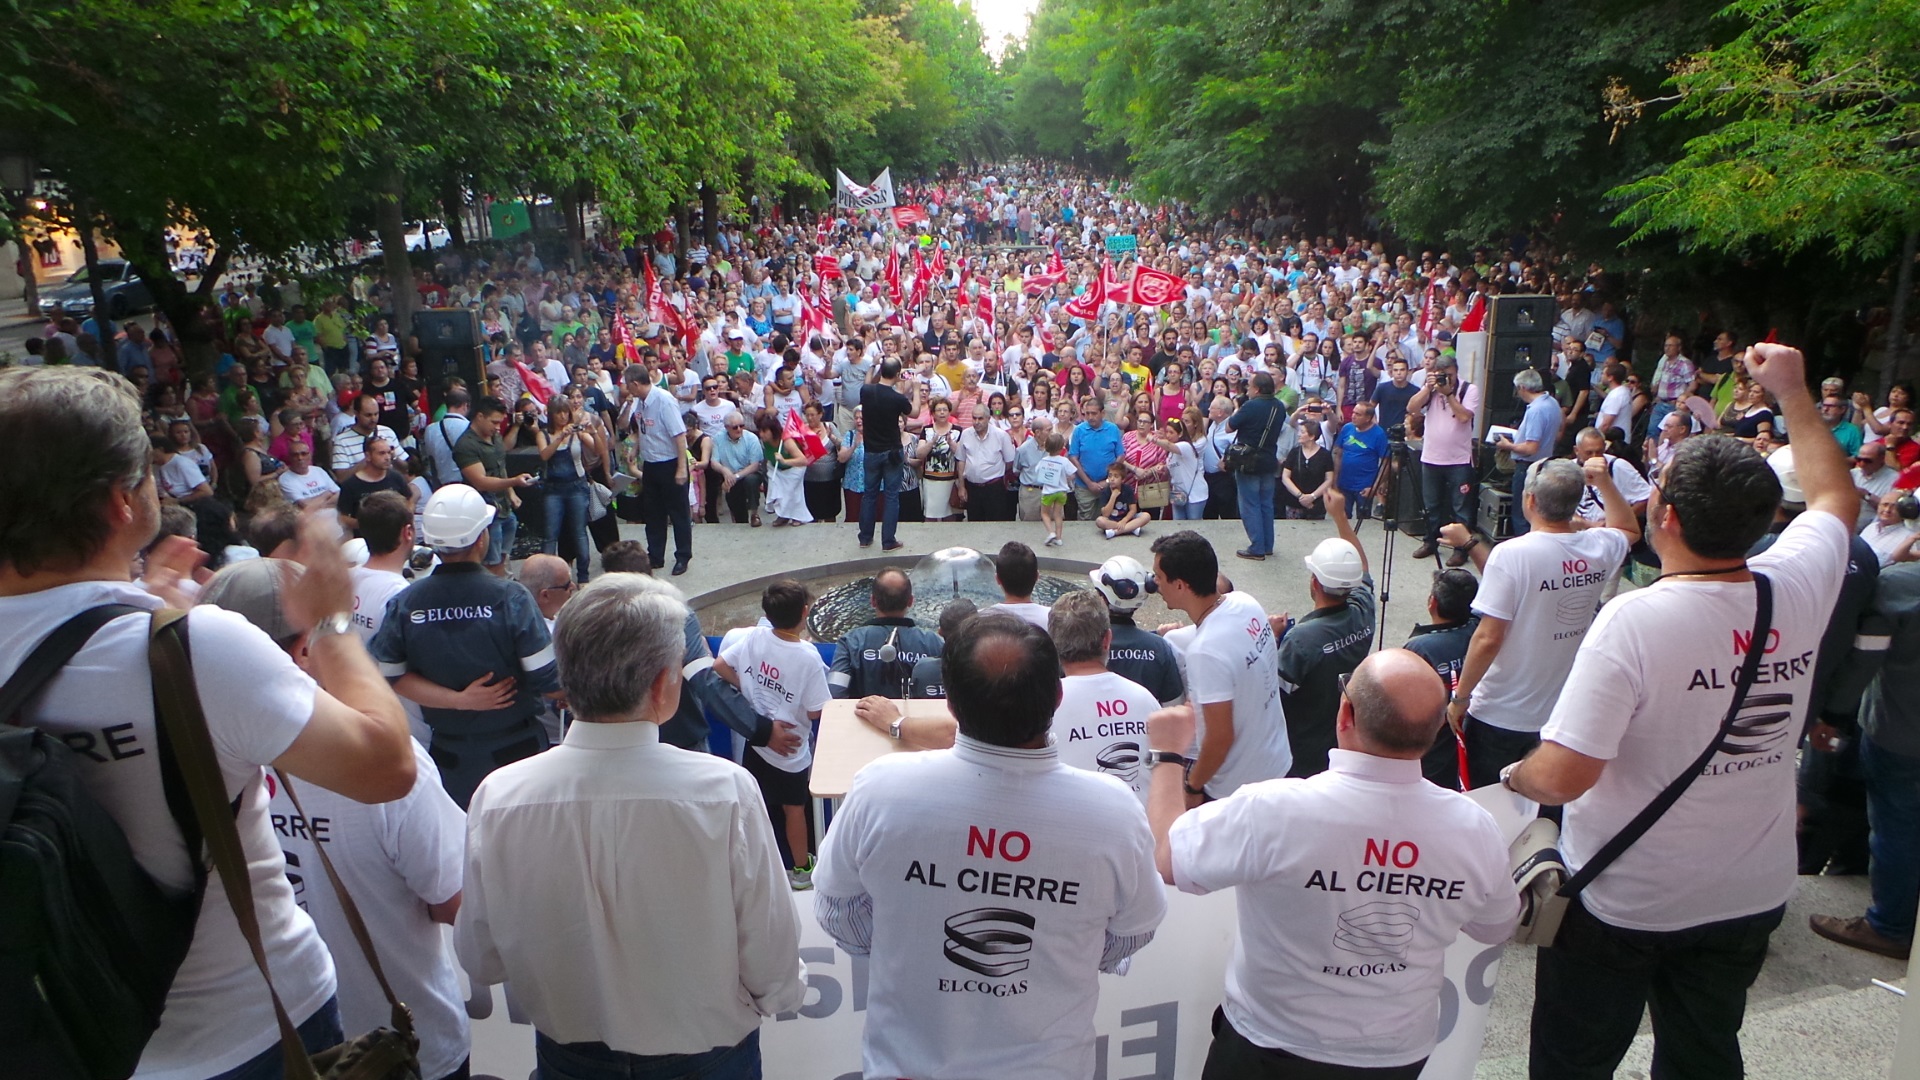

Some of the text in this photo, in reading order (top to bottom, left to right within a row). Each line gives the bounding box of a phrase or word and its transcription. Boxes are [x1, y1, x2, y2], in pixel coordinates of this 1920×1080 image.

[1562, 559, 1588, 575] NO
[1539, 569, 1606, 592] AL CIERRE
[428, 605, 493, 622] ELCOGAS
[1246, 617, 1261, 641] NO
[1334, 625, 1371, 651] ELCOGAS
[1733, 628, 1780, 656] NO
[1110, 648, 1155, 661] LCOGAS
[1246, 651, 1259, 670] AL
[760, 660, 780, 680] NO
[1687, 668, 1726, 691] AL
[1096, 699, 1128, 718] NO
[1069, 726, 1093, 742] AL
[1701, 751, 1783, 777] ELCOGAS
[967, 825, 1031, 863] NO
[1363, 838, 1419, 869] NO
[904, 860, 1080, 905] AL CIERRE
[1304, 869, 1465, 900] AL CIERRE
[1322, 962, 1408, 978] ELCOGAS
[938, 978, 1028, 998] ELCOGAS
